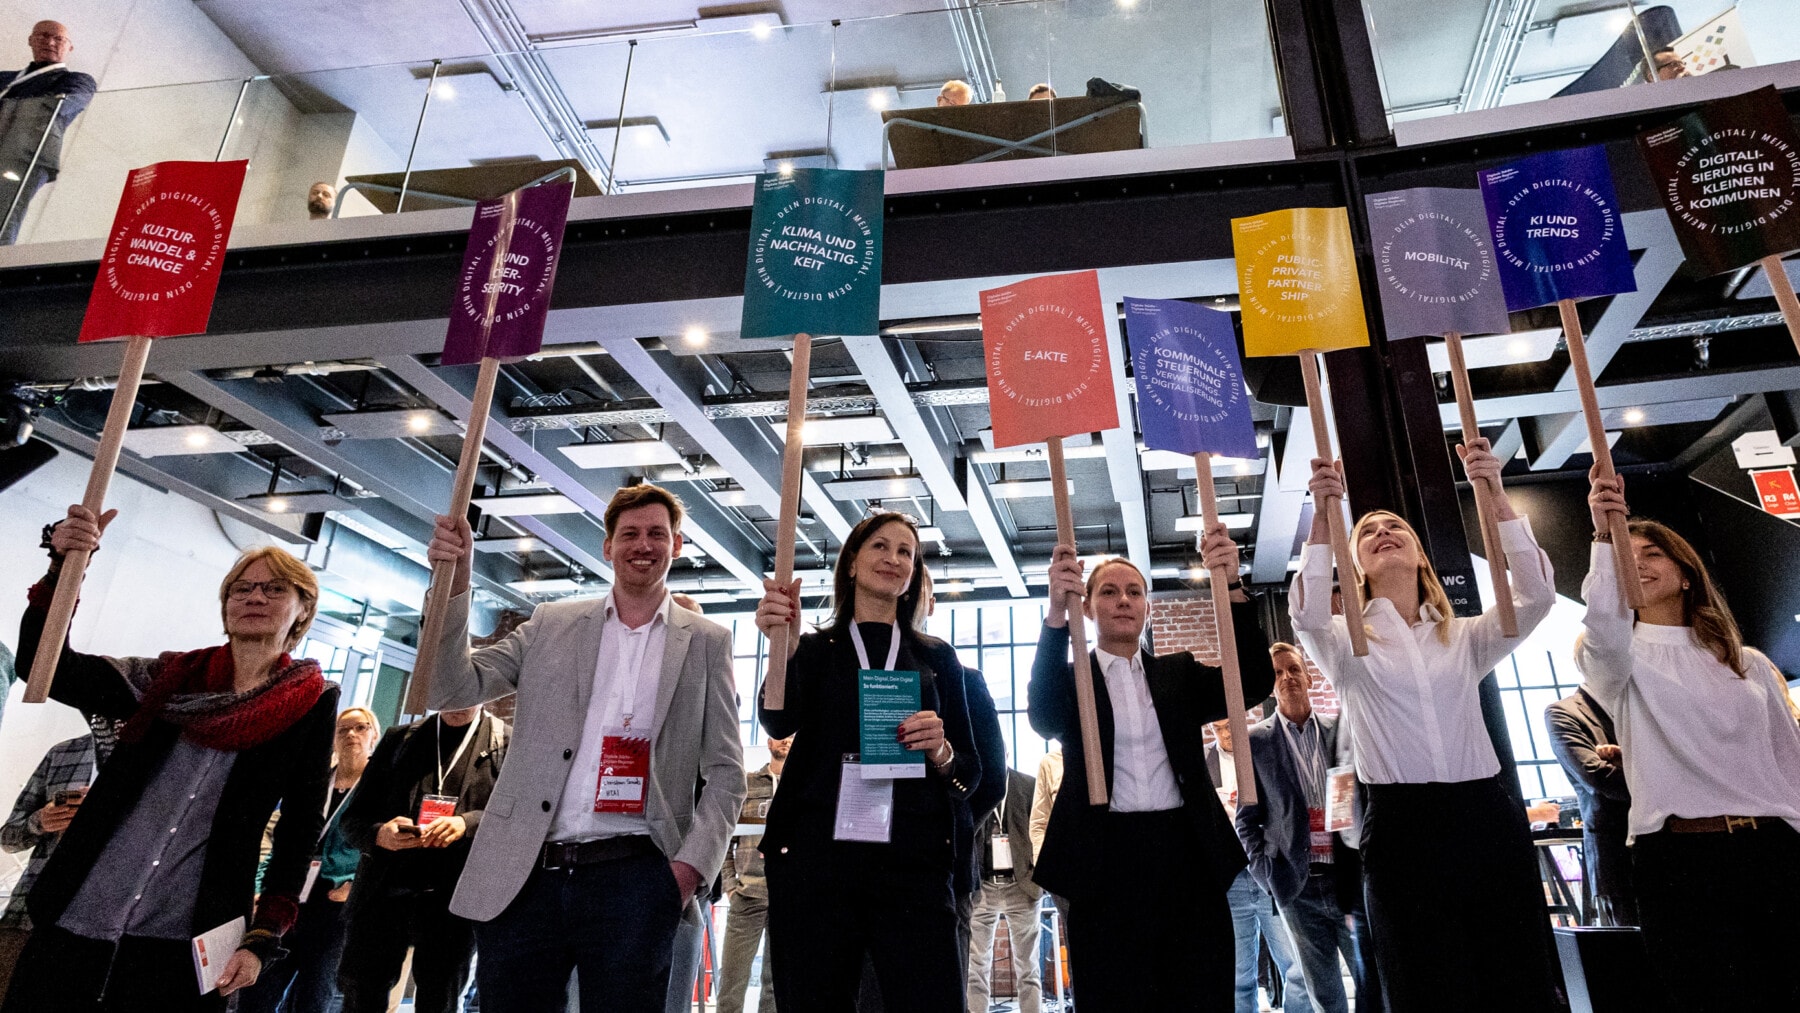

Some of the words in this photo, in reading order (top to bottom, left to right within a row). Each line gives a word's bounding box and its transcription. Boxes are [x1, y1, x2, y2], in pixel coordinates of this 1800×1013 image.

[1701, 129, 1746, 146] DIGITAL
[1761, 133, 1789, 151] MEIN
[1677, 146, 1699, 168] DEIN
[1699, 150, 1764, 169] DIGITALI-
[1691, 163, 1754, 184] SIERUNG
[1758, 161, 1774, 172] IN
[1532, 179, 1573, 190] DIGITAL
[1702, 176, 1764, 195] KLEINEN
[160, 191, 203, 206] DIGITAL
[805, 197, 845, 212] DIGITAL
[1508, 188, 1530, 206] DEIN
[1584, 188, 1606, 207] MEIN
[1668, 178, 1684, 212] DIGITAL
[1689, 187, 1781, 210] KOMMUNEN
[136, 196, 156, 215] DEIN
[777, 200, 800, 219] DEIN
[1769, 199, 1794, 220] DEIN
[208, 208, 223, 231] MEIN
[852, 214, 872, 236] MEIN
[1394, 217, 1415, 233] DEIN
[1418, 212, 1454, 225] DIGITAL
[1530, 215, 1543, 226] KI
[1546, 215, 1578, 226] UND
[1601, 208, 1614, 241] DIGITAL
[1681, 212, 1708, 231] MEIN
[1721, 216, 1766, 235] DIGITAL
[142, 223, 196, 244] KULTUR-
[781, 225, 822, 241] KLIMA
[825, 234, 857, 250] UND
[1464, 228, 1484, 247] MEIN
[1495, 216, 1507, 248] DIGITAL
[1526, 227, 1579, 239] TRENDS
[108, 226, 129, 263] DIGITAL
[130, 238, 183, 259] WANDEL
[186, 249, 197, 261] &
[201, 233, 223, 271] DIGITAL
[755, 228, 772, 264] DIGITAL
[769, 239, 859, 265] NACHHALTIG-
[1257, 239, 1278, 256] DEIN
[127, 253, 184, 274] CHANGE
[793, 255, 826, 271] KEIT
[857, 240, 874, 276] DIGITAL
[1381, 241, 1393, 273] DIGITAL
[1404, 251, 1471, 271] MOBILITÄT
[1480, 250, 1491, 281] DIGITAL
[1502, 249, 1524, 267] MEIN
[1577, 249, 1601, 266] DEIN
[462, 256, 482, 292] DIGITAL
[536, 255, 554, 293] DIGITAL
[1534, 262, 1574, 273] DIGITAL
[107, 267, 119, 290] MEIN
[757, 266, 775, 289] MEIN
[1244, 264, 1255, 294] DIGITAL
[1267, 279, 1326, 292] PARTNER-
[1388, 275, 1409, 294] MEIN
[120, 289, 159, 301] DIGITAL
[166, 281, 193, 299] DEIN
[782, 289, 822, 300] DIGITAL
[828, 283, 853, 299] DEIN
[1280, 291, 1309, 301] SHIP
[1418, 294, 1457, 304] DIGITAL
[1459, 288, 1479, 302] DEIN
[507, 303, 530, 321] DEIN
[1028, 304, 1065, 315] DIGITAL
[1249, 296, 1268, 315] MEIN
[1006, 313, 1025, 332] DEIN
[1075, 315, 1096, 335] MEIN
[1277, 313, 1314, 322] DIGITAL
[1150, 328, 1170, 343] DEIN
[1173, 326, 1207, 343] DIGITAL
[992, 342, 1004, 377] DIGITAL
[1024, 350, 1068, 363] E-AKTE
[1089, 337, 1102, 373] DIGITAL
[1138, 348, 1149, 380] DIGITAL
[1153, 346, 1227, 380] KOMMUNALE
[1214, 348, 1233, 369] MEIN
[1156, 358, 1222, 388] STEUERUNG
[997, 379, 1017, 399] MEIN
[1066, 382, 1088, 400] DEIN
[1151, 377, 1224, 408] DIGITALISIERUNG
[1155, 369, 1221, 397] VERWALTUNGS-
[1228, 372, 1239, 405] DIGITAL
[1025, 397, 1062, 407] DIGITAL
[1144, 383, 1164, 406] MEIN
[1172, 409, 1209, 422] DIGITAL
[1210, 409, 1229, 423] DEIN
[1782, 492, 1796, 501] R4
[1441, 575, 1466, 586] WC
